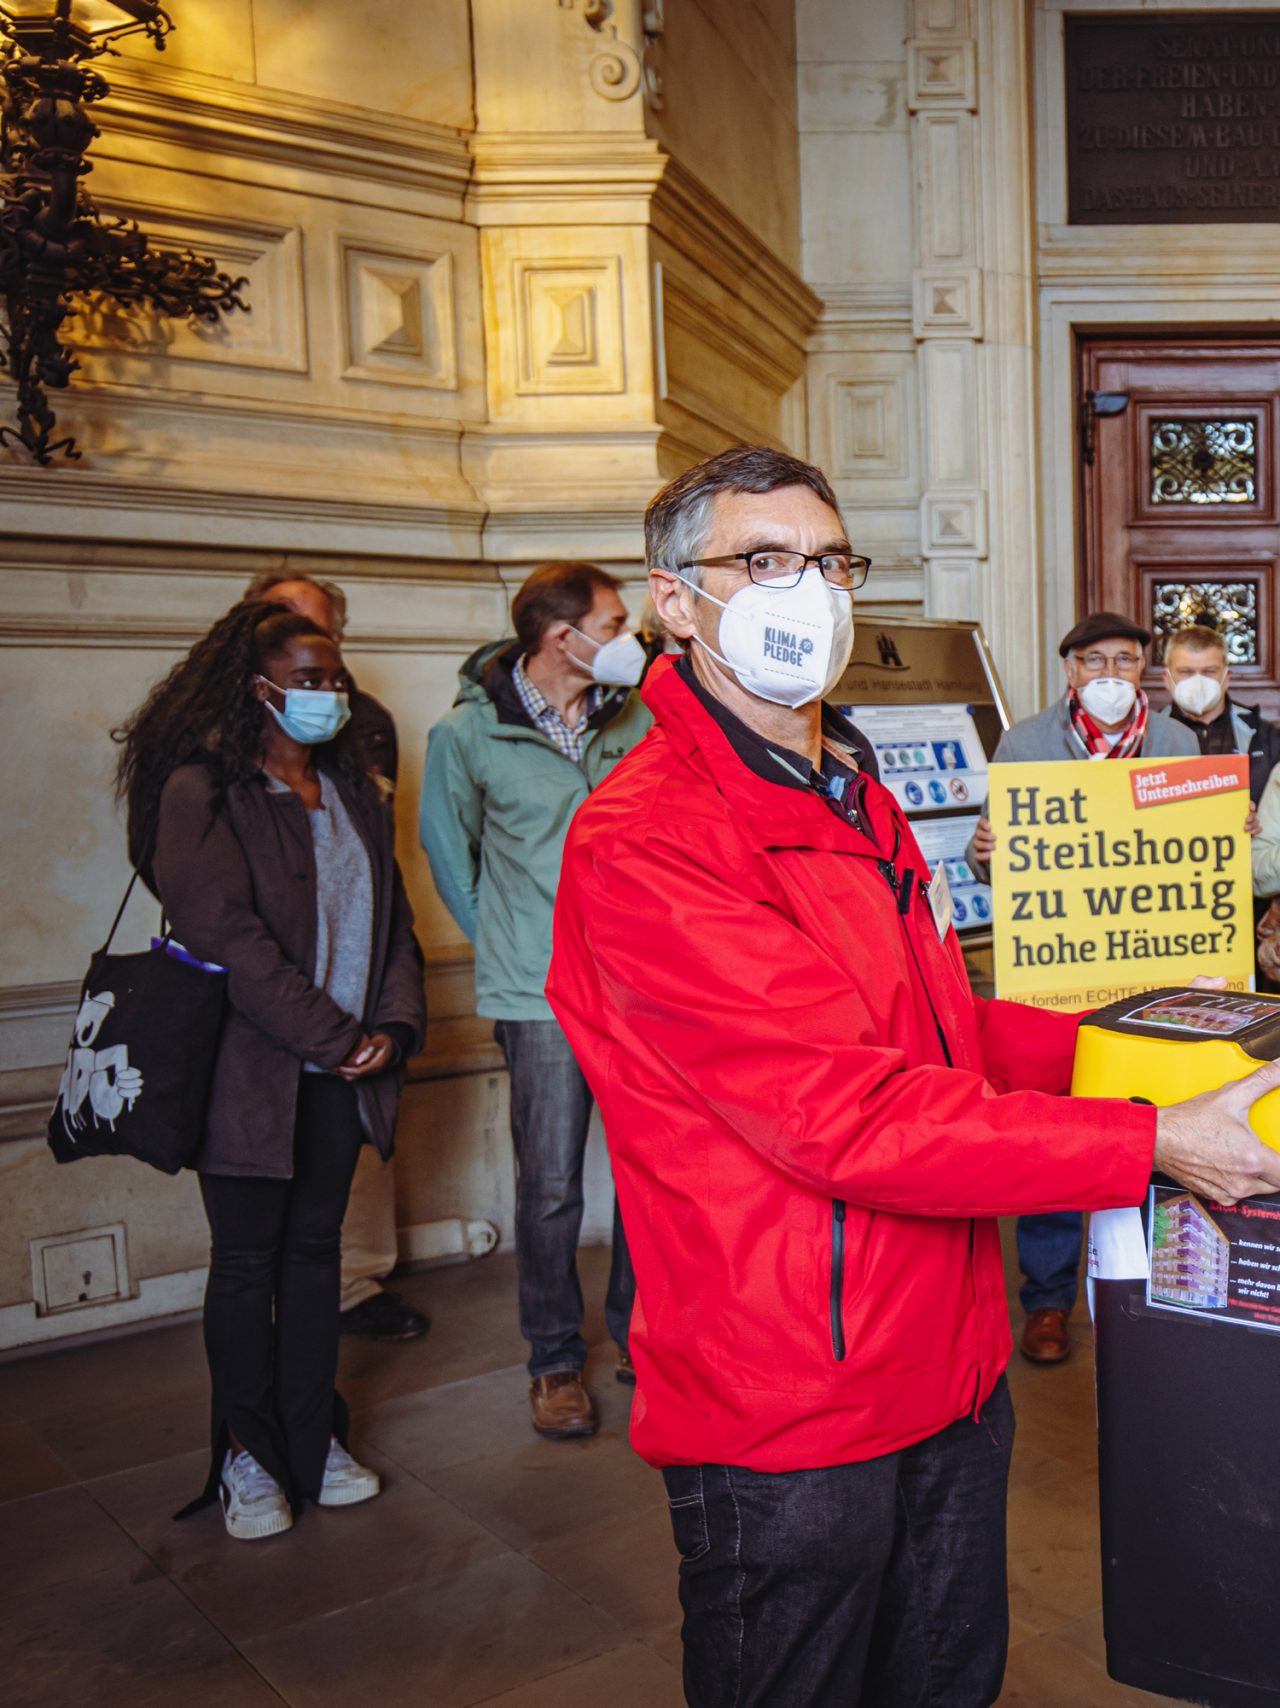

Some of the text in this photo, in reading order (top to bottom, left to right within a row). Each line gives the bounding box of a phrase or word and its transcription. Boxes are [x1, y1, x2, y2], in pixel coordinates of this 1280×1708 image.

[764, 626, 797, 650] KLIMA
[763, 642, 803, 667] PLEDGE
[1134, 771, 1168, 789] Jetzt
[1136, 773, 1240, 803] Unterschreiben
[1007, 787, 1088, 827] Hat
[1008, 829, 1236, 873] Steilshoop
[1011, 871, 1237, 922] zu wenig
[1012, 924, 1237, 967] hohe Häuser?
[1238, 1239, 1263, 1250] kennen
[1264, 1242, 1275, 1251] wir
[1238, 1258, 1259, 1268] haben
[1238, 1278, 1255, 1287] mehr
[1256, 1281, 1276, 1290] davon
[1238, 1287, 1250, 1295] wir
